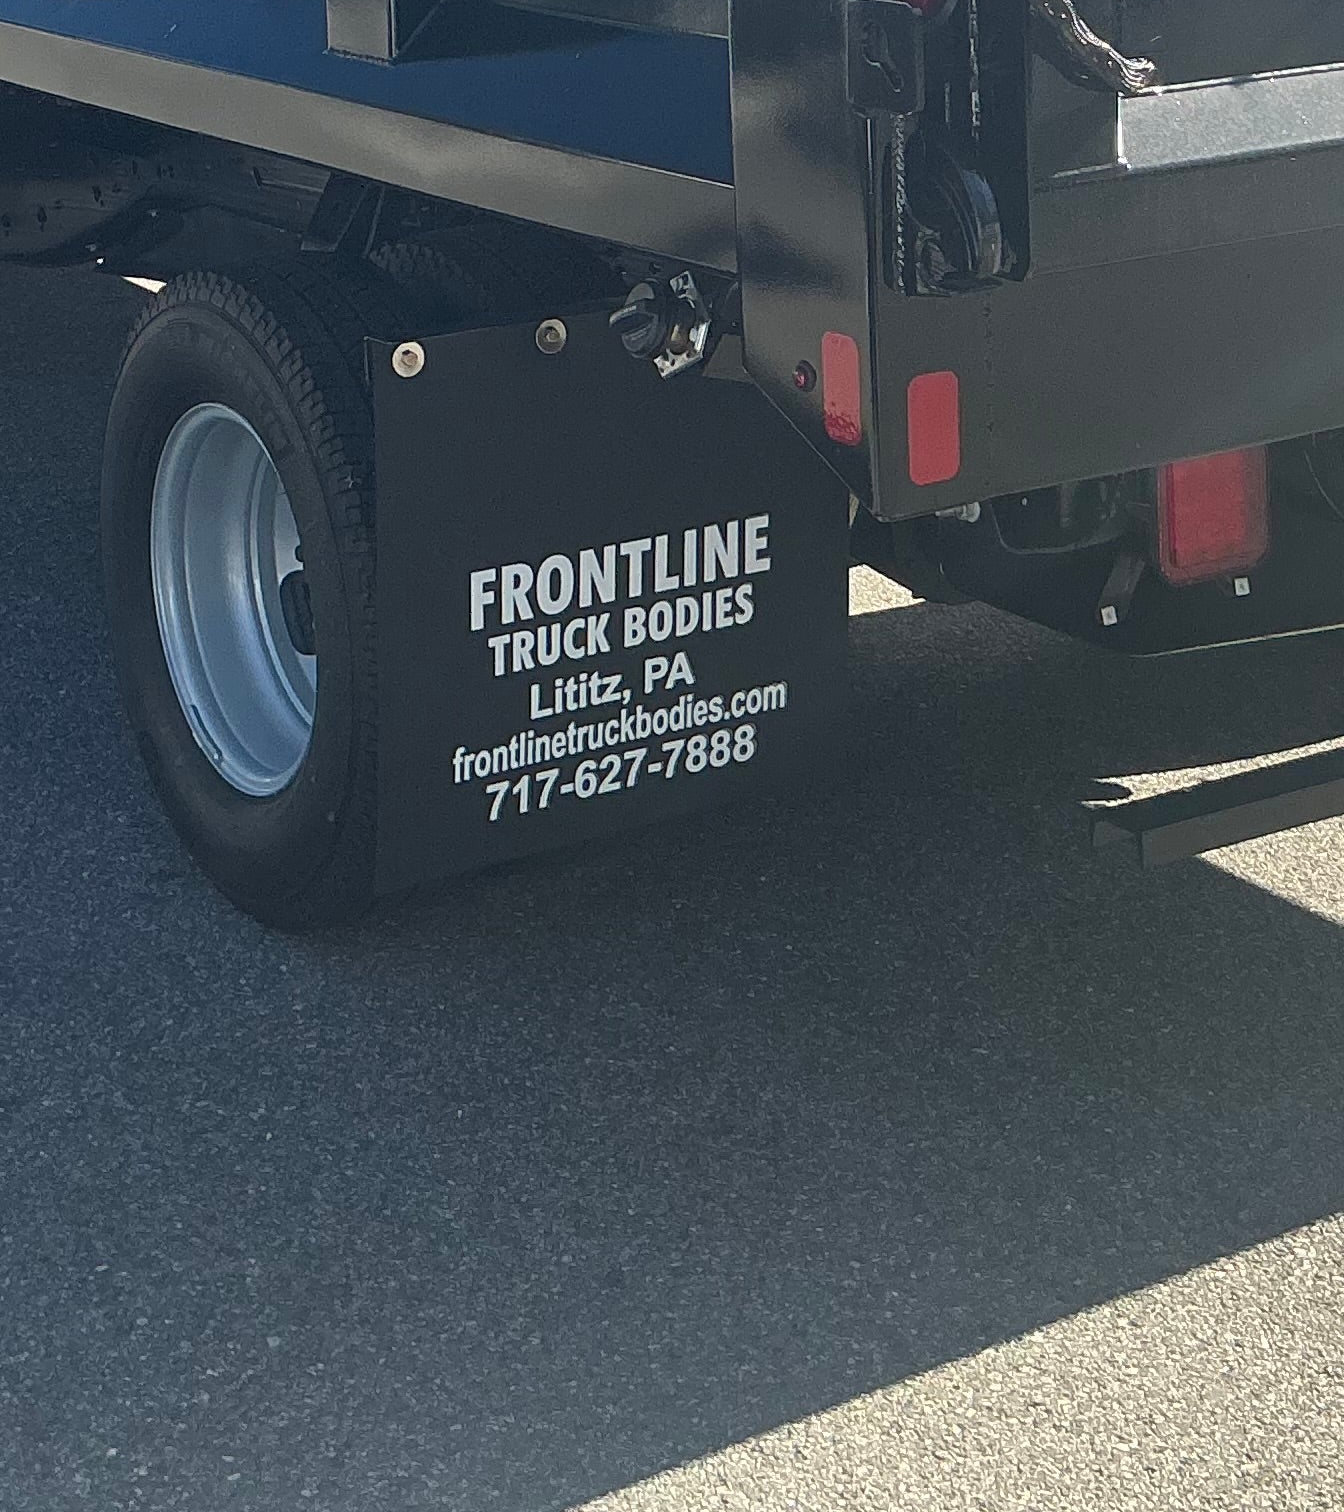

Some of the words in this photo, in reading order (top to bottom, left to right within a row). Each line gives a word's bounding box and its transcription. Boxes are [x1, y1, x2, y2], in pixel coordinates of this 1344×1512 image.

[469, 513, 771, 631] FRONTLINE
[487, 612, 611, 677] TRUCK
[622, 583, 754, 649] BODIES
[452, 680, 789, 785] frontlinetruckbodies.com
[529, 670, 633, 721] Lititz,
[643, 651, 696, 695] PA
[485, 724, 757, 822] 717-627-7888
